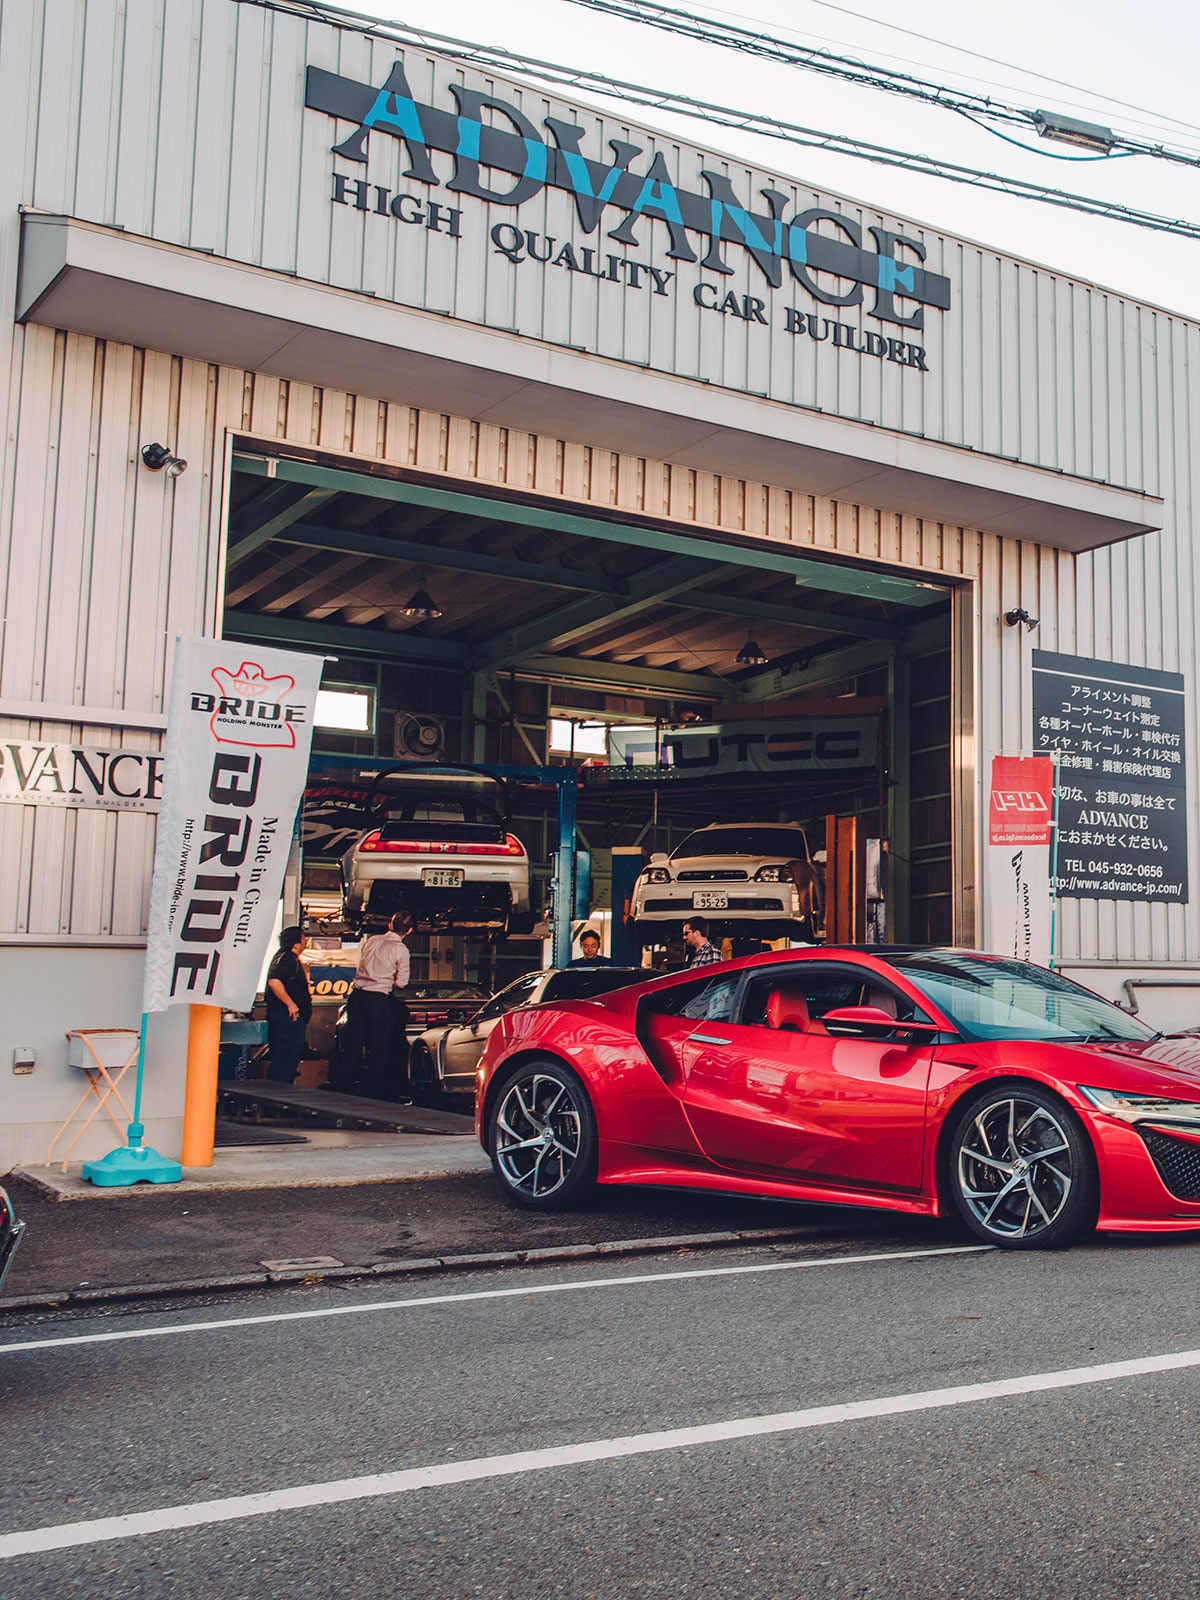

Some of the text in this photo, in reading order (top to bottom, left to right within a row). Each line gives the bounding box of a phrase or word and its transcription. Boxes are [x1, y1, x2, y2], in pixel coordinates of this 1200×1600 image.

[331, 61, 928, 331] ADVANCE
[331, 172, 930, 372] HIGH QUALITY CAR BUILDER
[190, 692, 307, 723] BRIDE
[1070, 685, 1152, 709] アライメント調整
[217, 717, 283, 729] HOLDING MONSTER
[0, 744, 165, 800] VANCE
[1053, 754, 1172, 780] 金修理・損害保険代理店
[0, 793, 51, 801] UALITY
[96, 799, 146, 807] BUILDER
[1077, 810, 1149, 830] ADVANCE
[1056, 829, 1169, 852] におまかせください。
[169, 752, 262, 997] BRIDE
[1065, 859, 1163, 878] TEL 045-932-0656
[233, 816, 279, 948] Made in Circuit.
[1049, 876, 1183, 896] ttp://www.advance-jp.com/
[701, 898, 726, 907] 95-25
